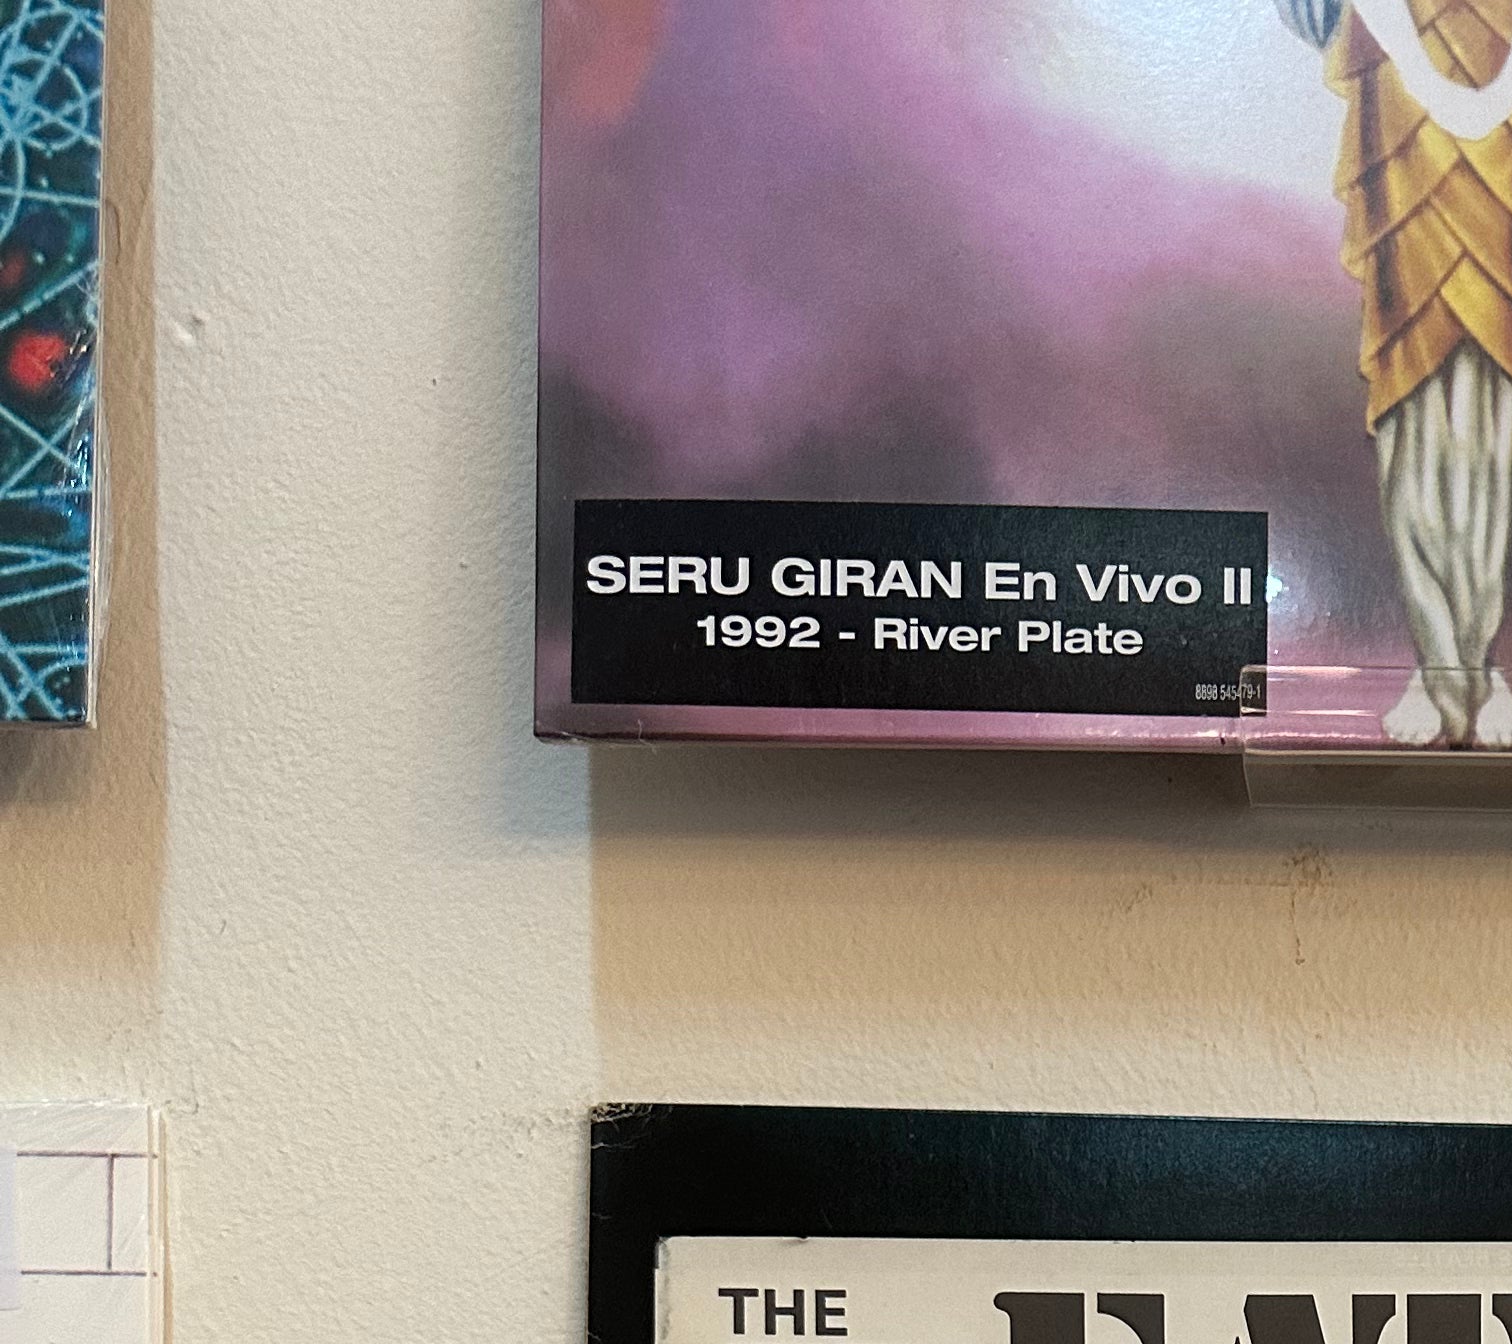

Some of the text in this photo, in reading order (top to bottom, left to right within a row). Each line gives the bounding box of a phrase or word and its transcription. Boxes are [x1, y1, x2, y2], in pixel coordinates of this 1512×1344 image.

[586, 554, 1252, 605] SERU GIRAN En Vivo II
[696, 614, 1144, 655] 1992 - River Plate
[717, 1287, 848, 1337] THE
